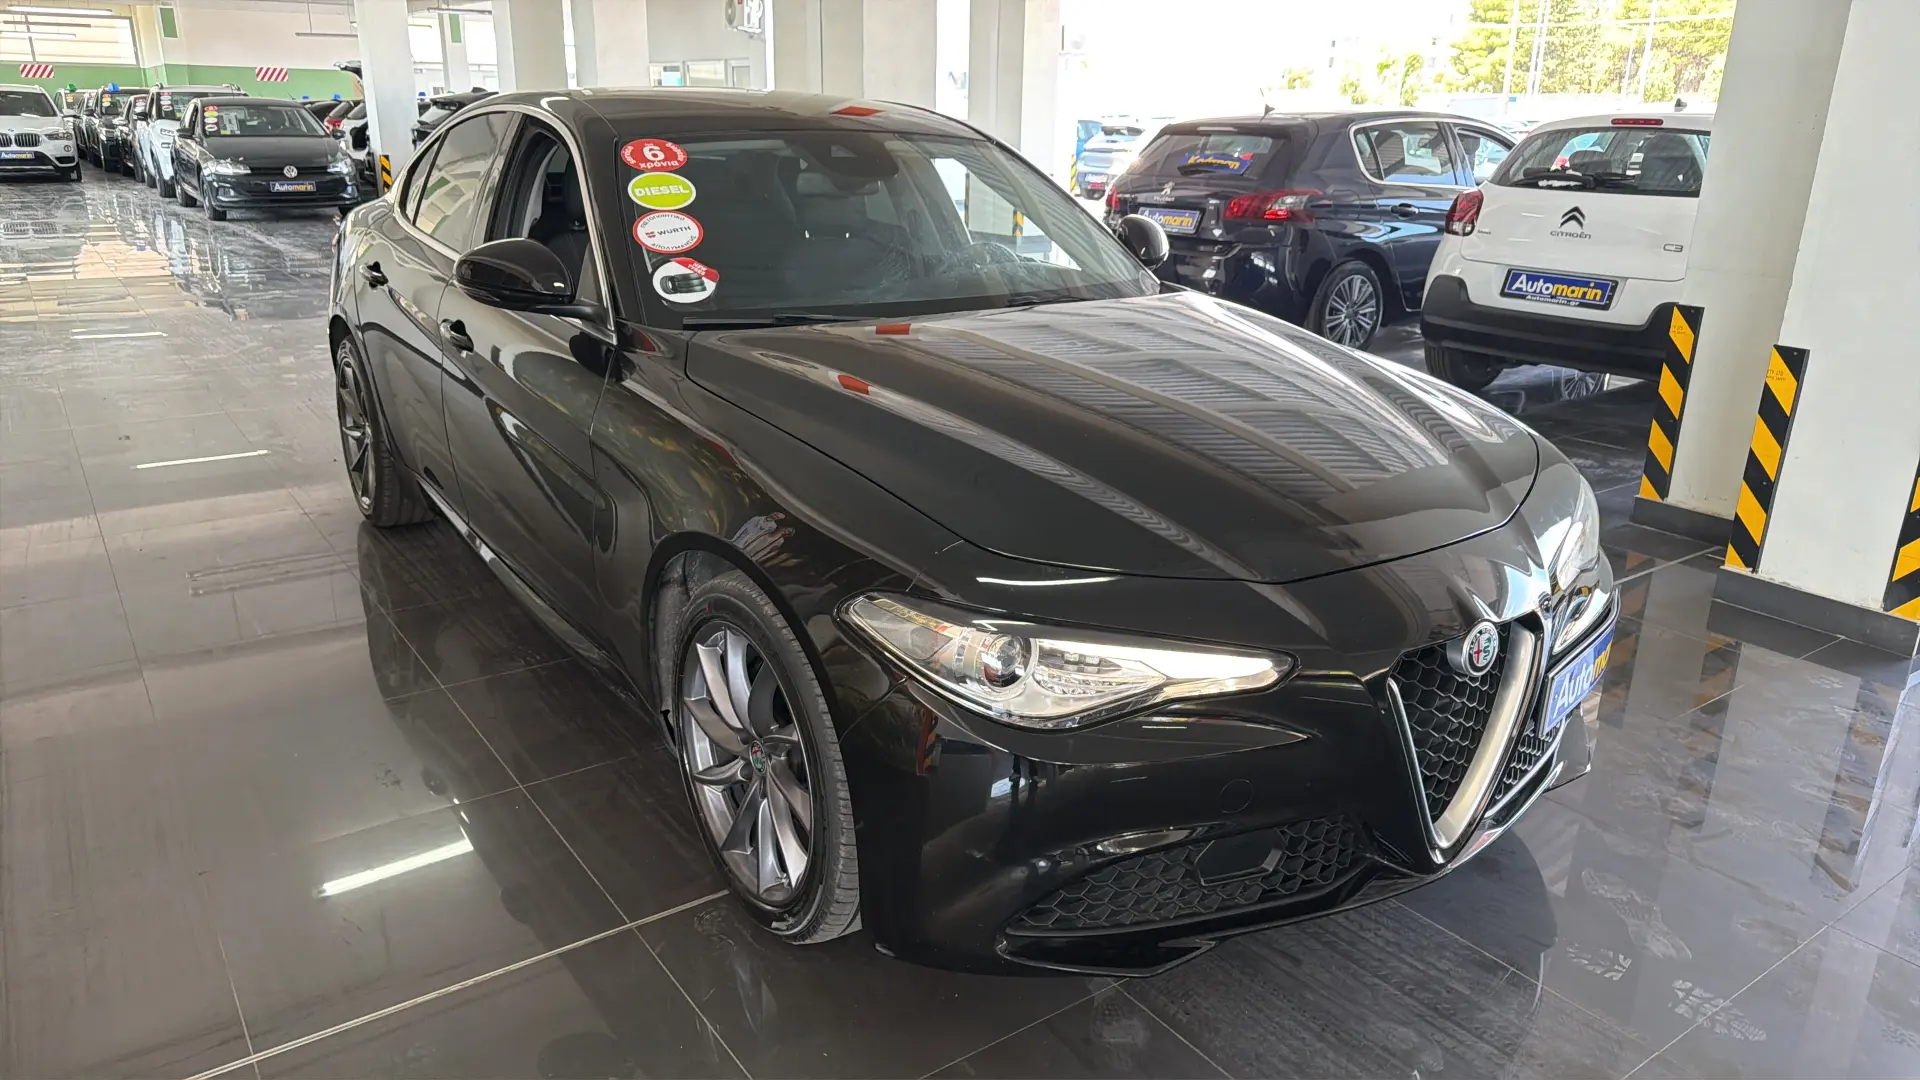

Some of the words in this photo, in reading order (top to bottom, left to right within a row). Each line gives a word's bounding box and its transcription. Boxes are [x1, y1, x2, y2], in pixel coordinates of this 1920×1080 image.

[1, 151, 33, 159] Automarin
[642, 145, 665, 161] 6
[639, 160, 679, 169] χρόνια
[274, 182, 313, 192] Automarin
[634, 185, 690, 197] DIESEL
[1663, 243, 1684, 253] C3
[687, 264, 707, 276] TYRES
[692, 261, 708, 272] NEW
[1511, 273, 1603, 301] Automarin
[1526, 294, 1580, 307] Automarin.gr
